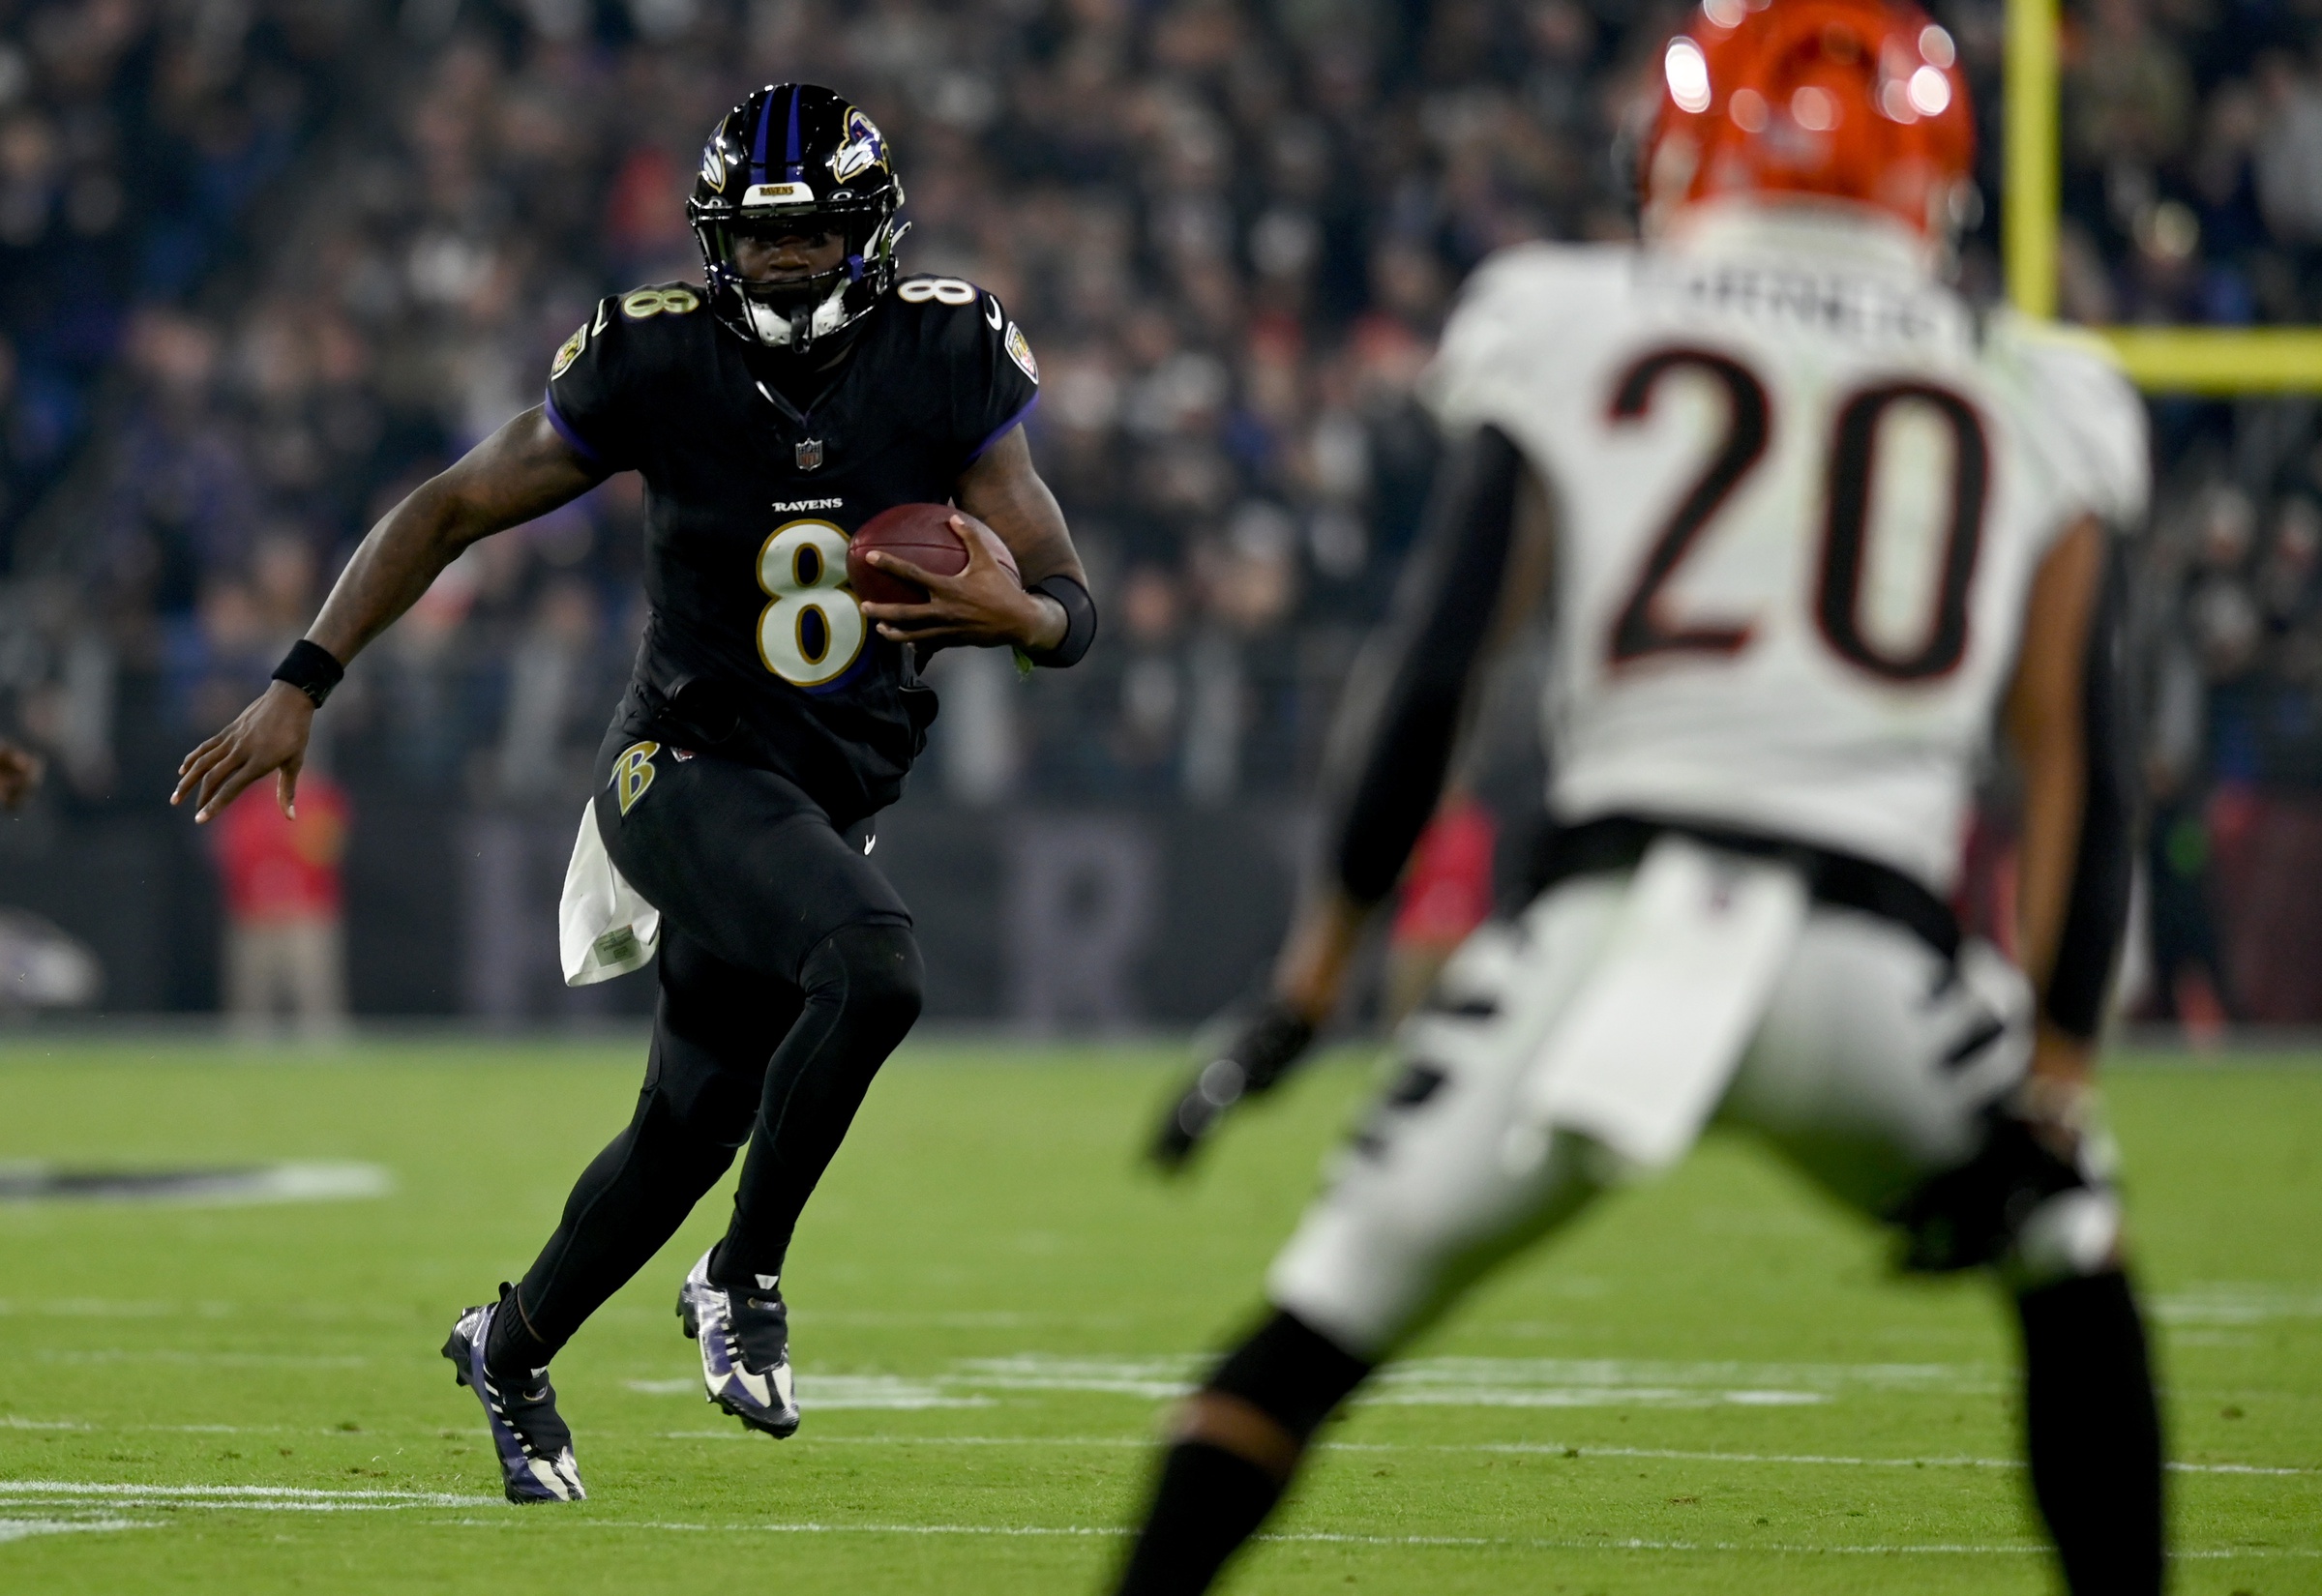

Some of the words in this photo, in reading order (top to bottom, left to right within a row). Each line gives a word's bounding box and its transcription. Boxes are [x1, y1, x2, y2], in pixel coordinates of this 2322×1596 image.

[759, 186, 794, 196] RAVENS
[622, 290, 700, 318] 8
[898, 279, 975, 306] 8
[772, 497, 844, 513] RAVENS
[1601, 346, 1988, 682] 20
[756, 518, 868, 688] 8
[607, 741, 661, 817] B
